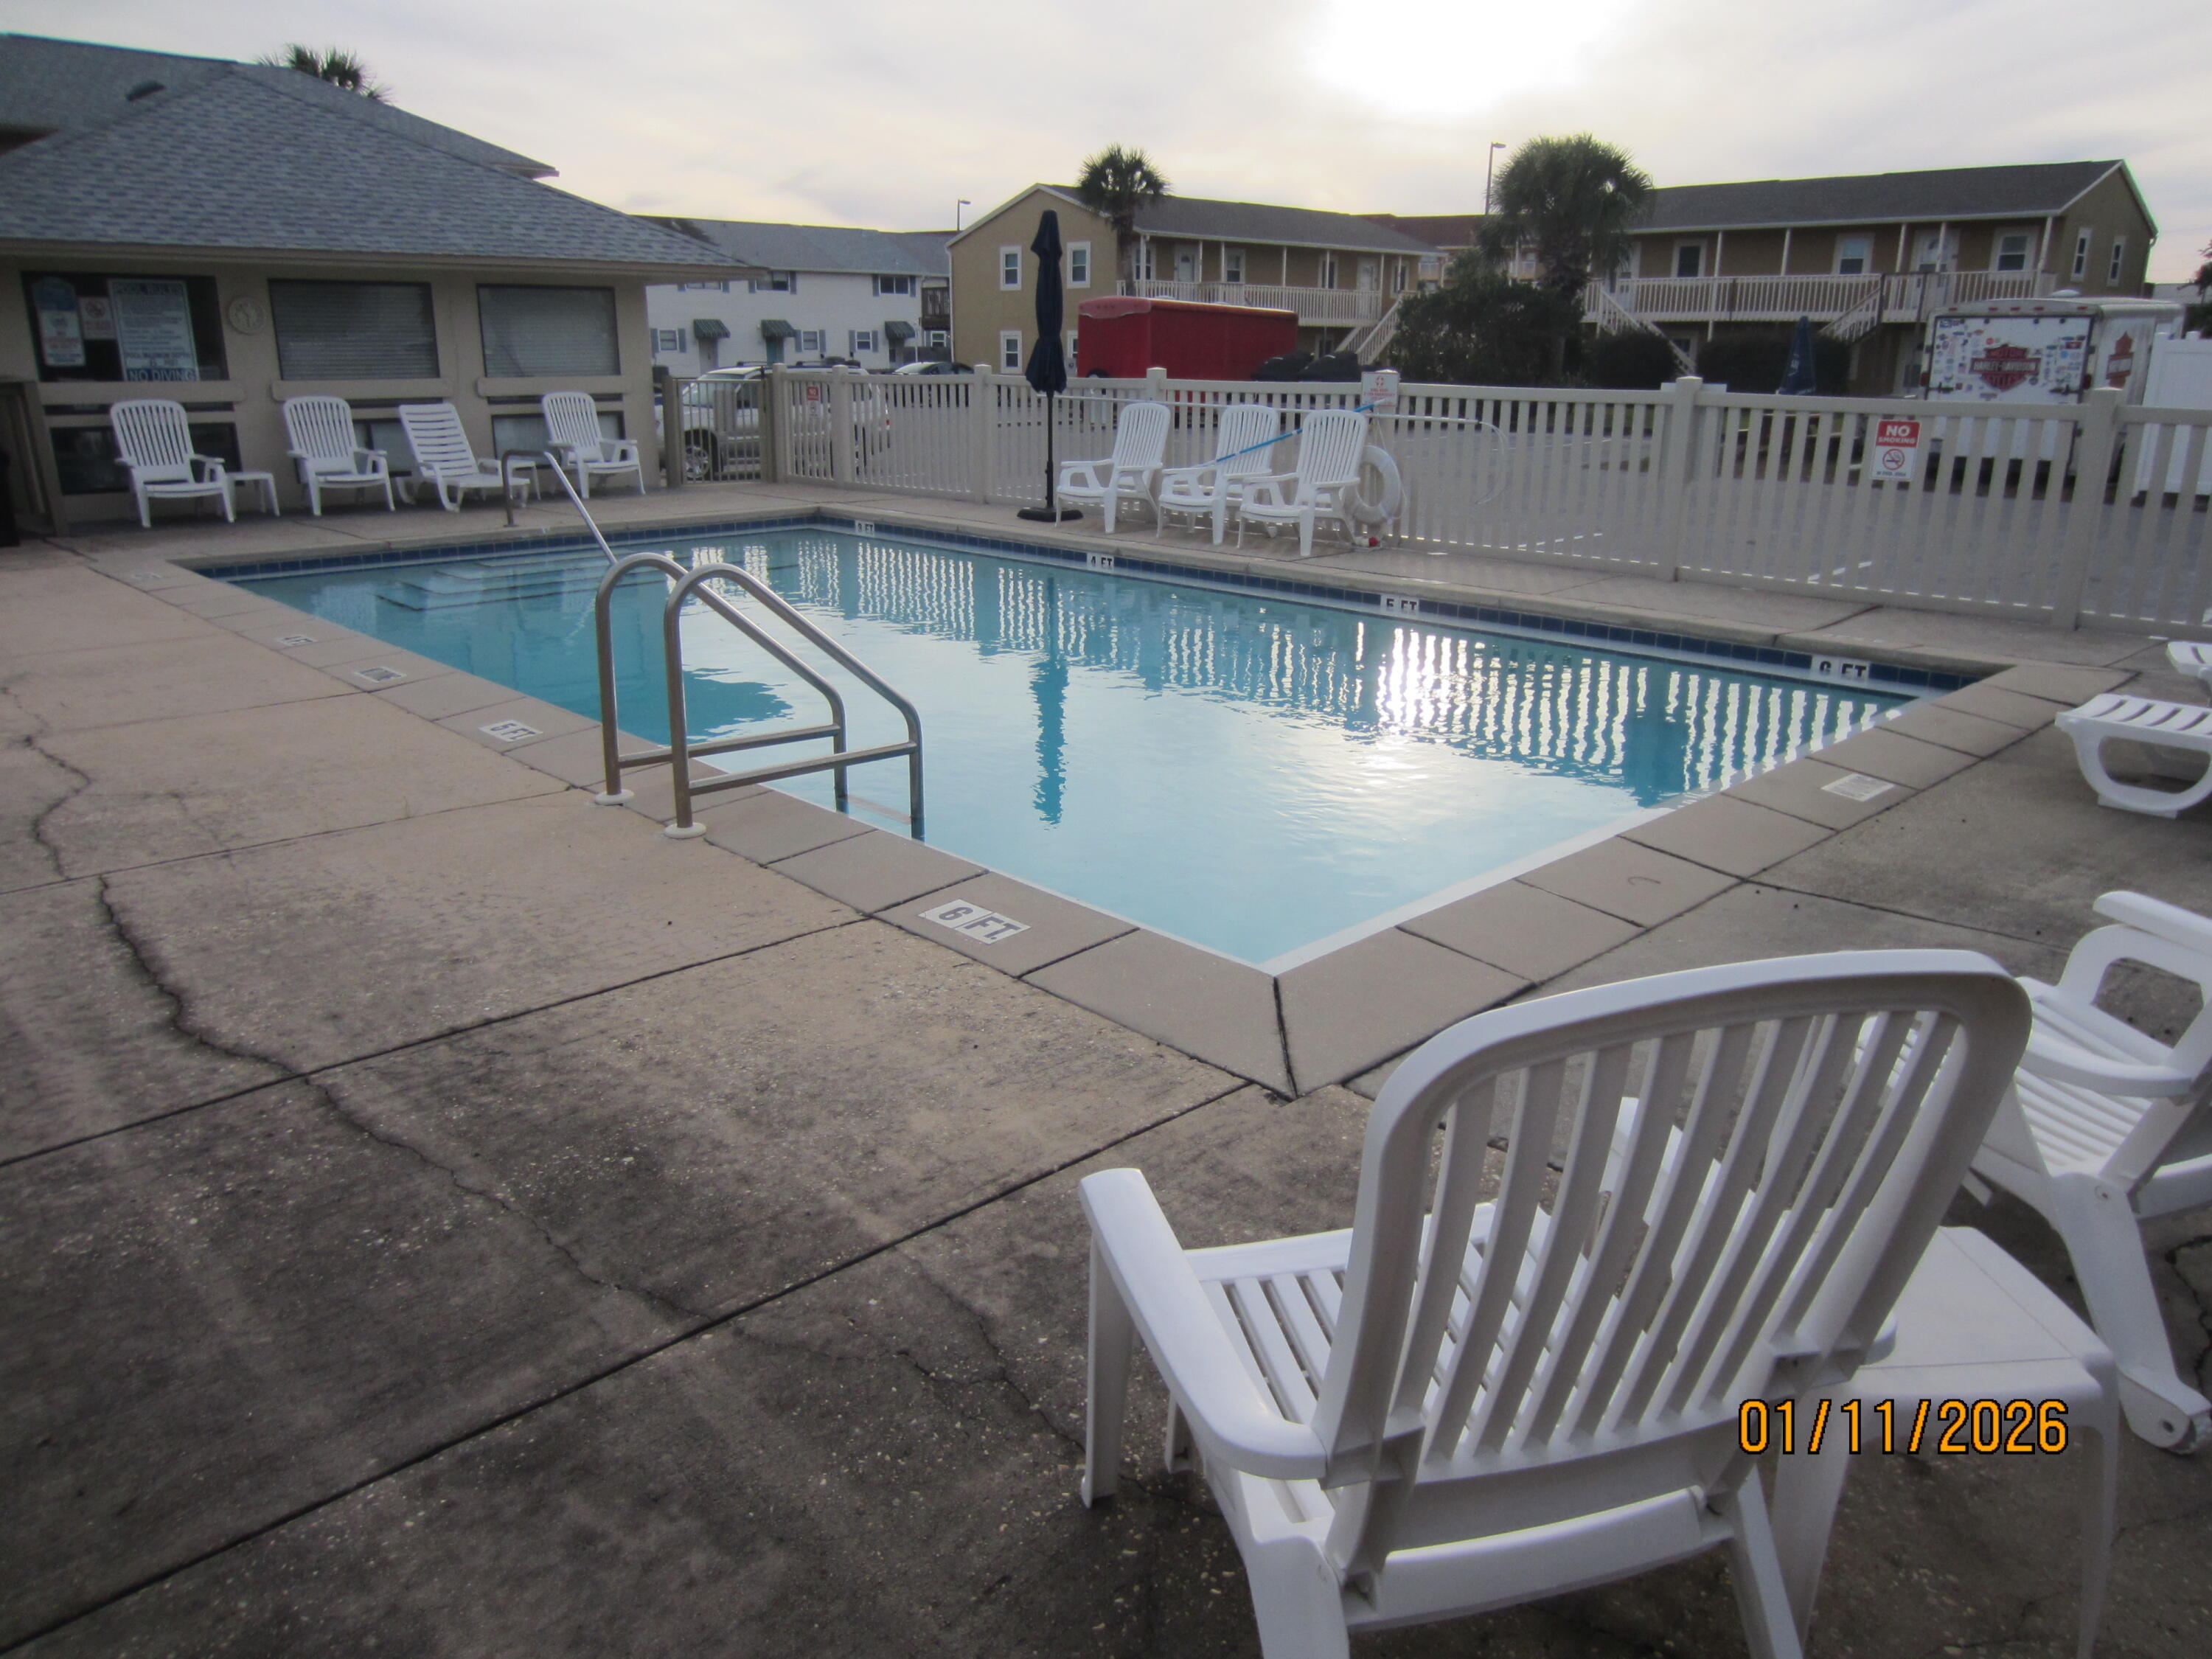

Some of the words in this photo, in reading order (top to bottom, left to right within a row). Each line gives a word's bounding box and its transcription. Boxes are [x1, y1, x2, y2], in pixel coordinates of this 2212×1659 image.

[129, 369, 148, 381] NO
[152, 369, 193, 381] DIVING
[1885, 425, 1910, 437] NO
[865, 524, 873, 532] FT
[1101, 557, 1113, 567] FT
[1401, 600, 1417, 611] FT
[1842, 663, 1866, 678] FT
[501, 728, 536, 740] FT
[939, 907, 973, 920] 6
[963, 916, 1021, 940] FT.
